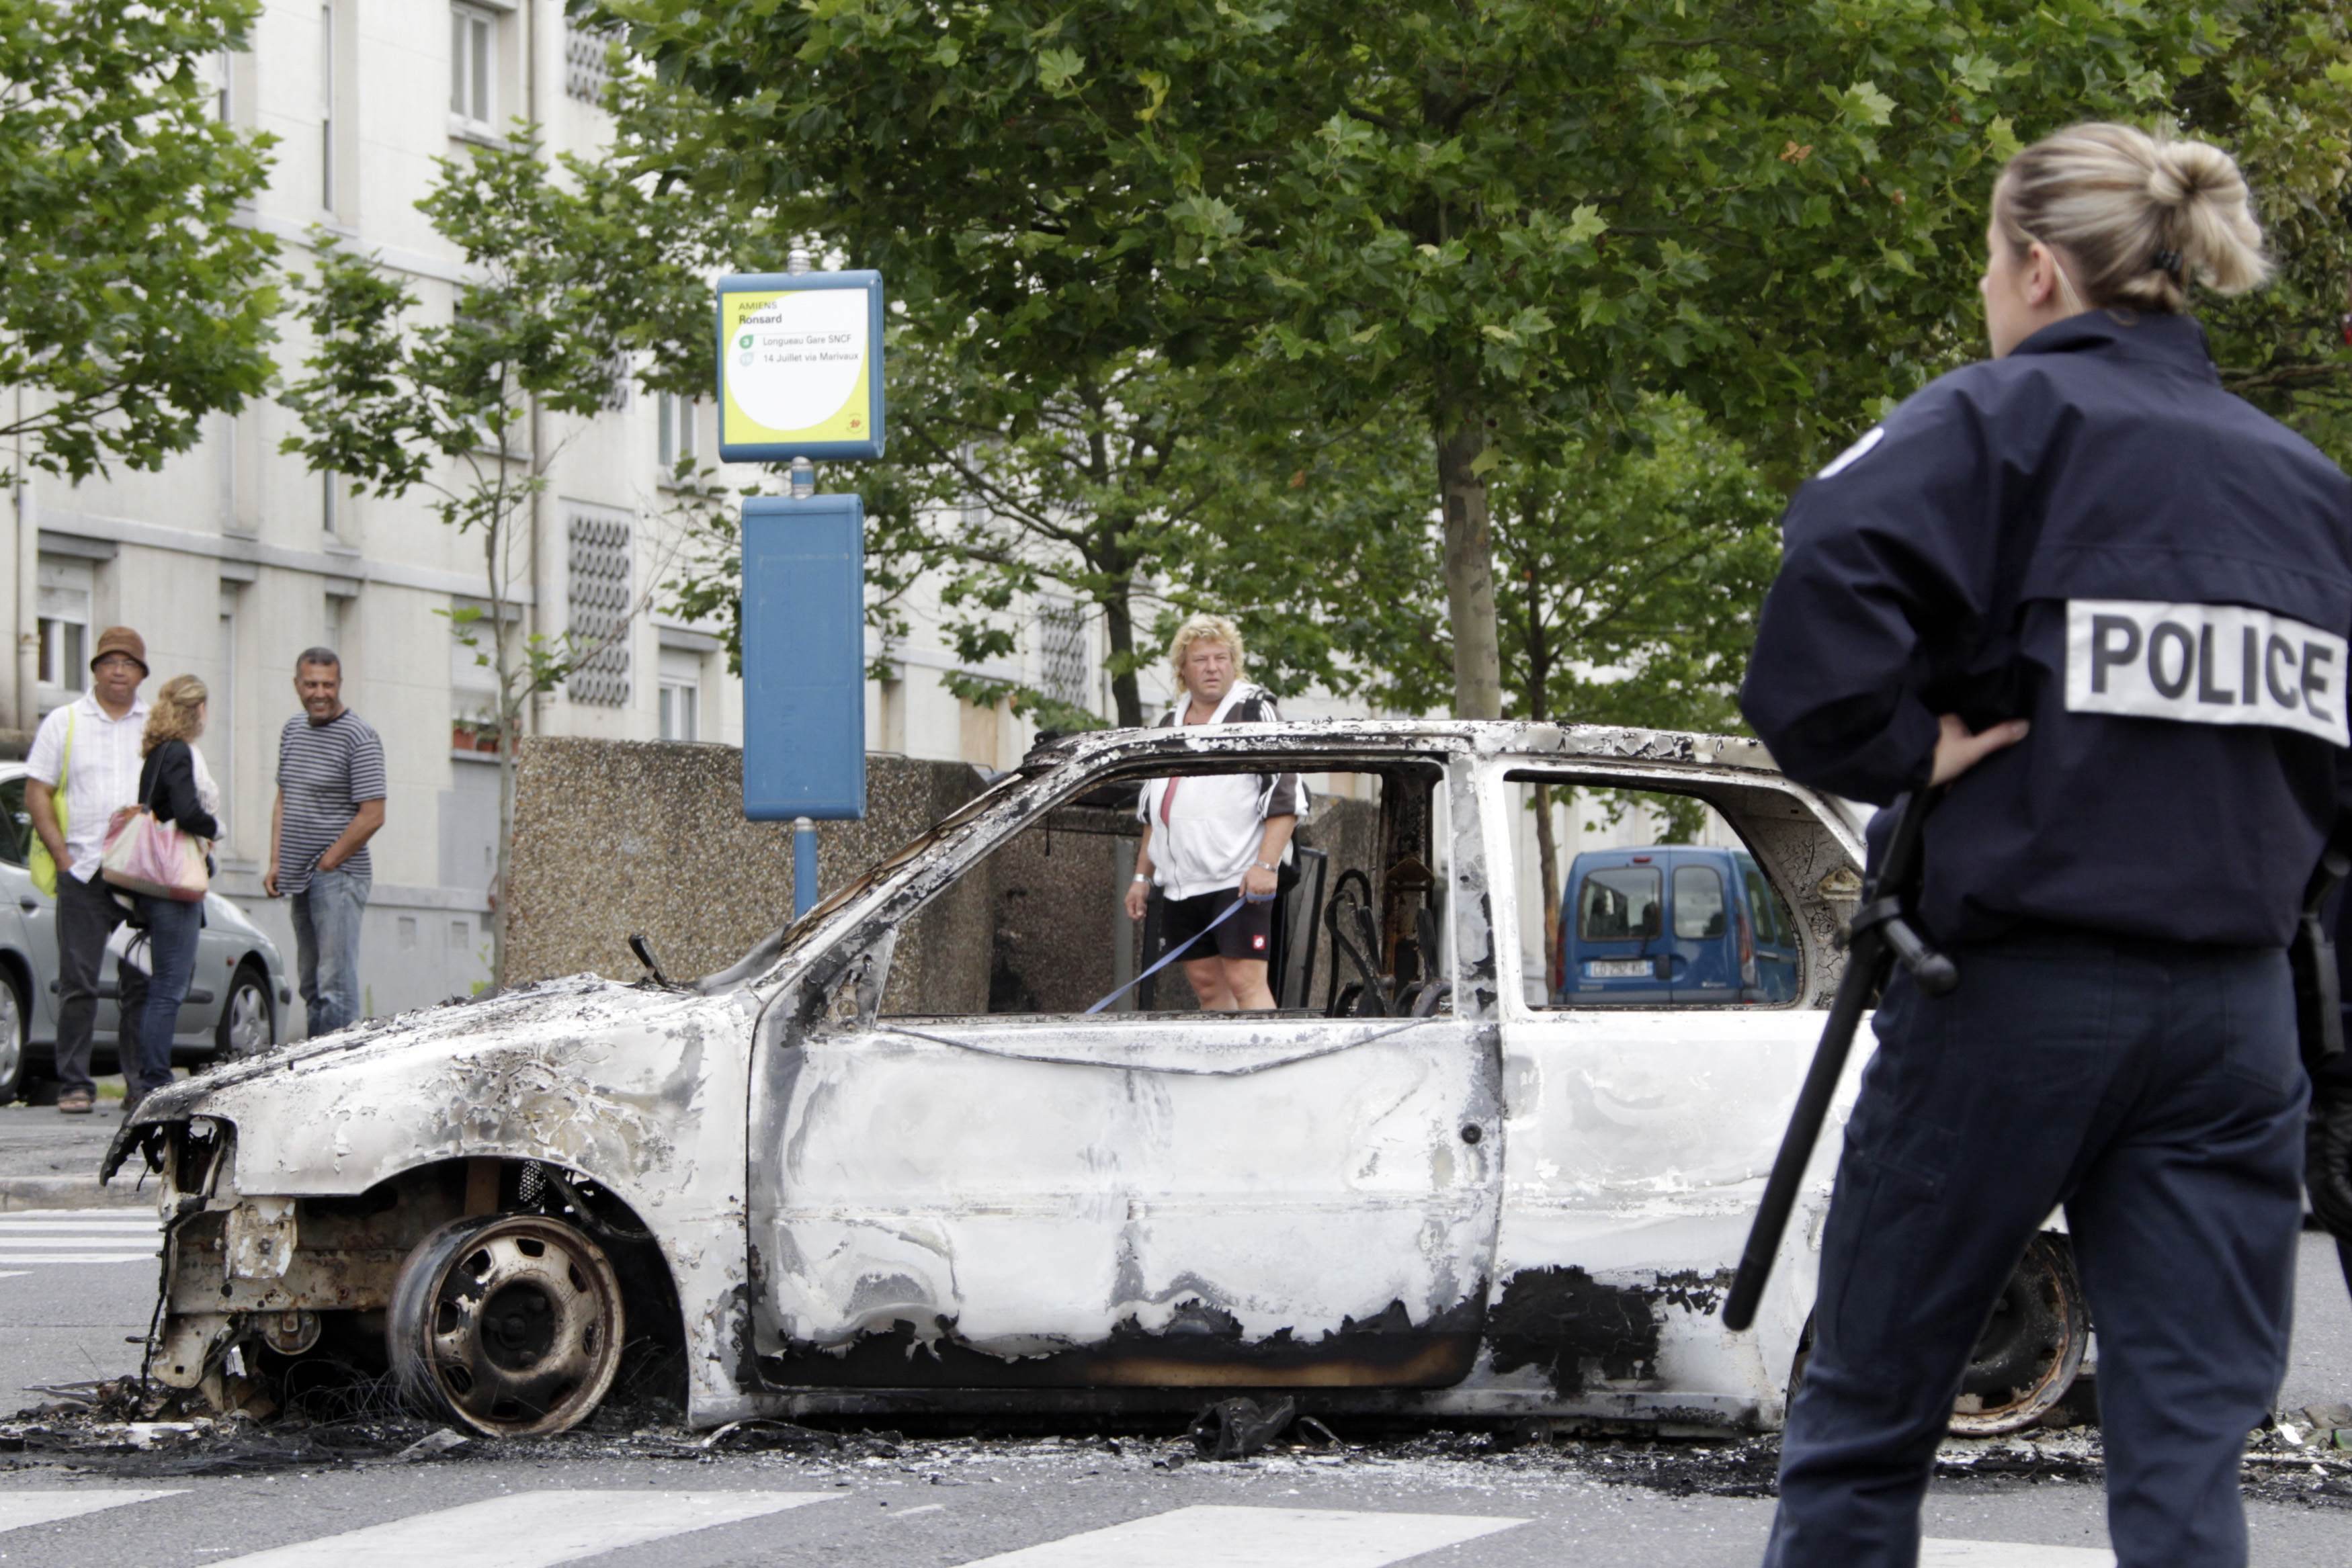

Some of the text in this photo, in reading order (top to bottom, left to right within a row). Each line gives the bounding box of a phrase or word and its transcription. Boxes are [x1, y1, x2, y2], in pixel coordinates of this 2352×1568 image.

[739, 301, 778, 310] AMIENS
[739, 313, 782, 324] Ronsard
[763, 337, 804, 347] Longueau
[806, 335, 825, 344] Gare
[829, 334, 851, 343] SNCF
[763, 351, 859, 363] 14 Juillet via Marivaux
[2091, 613, 2335, 724] POLICE
